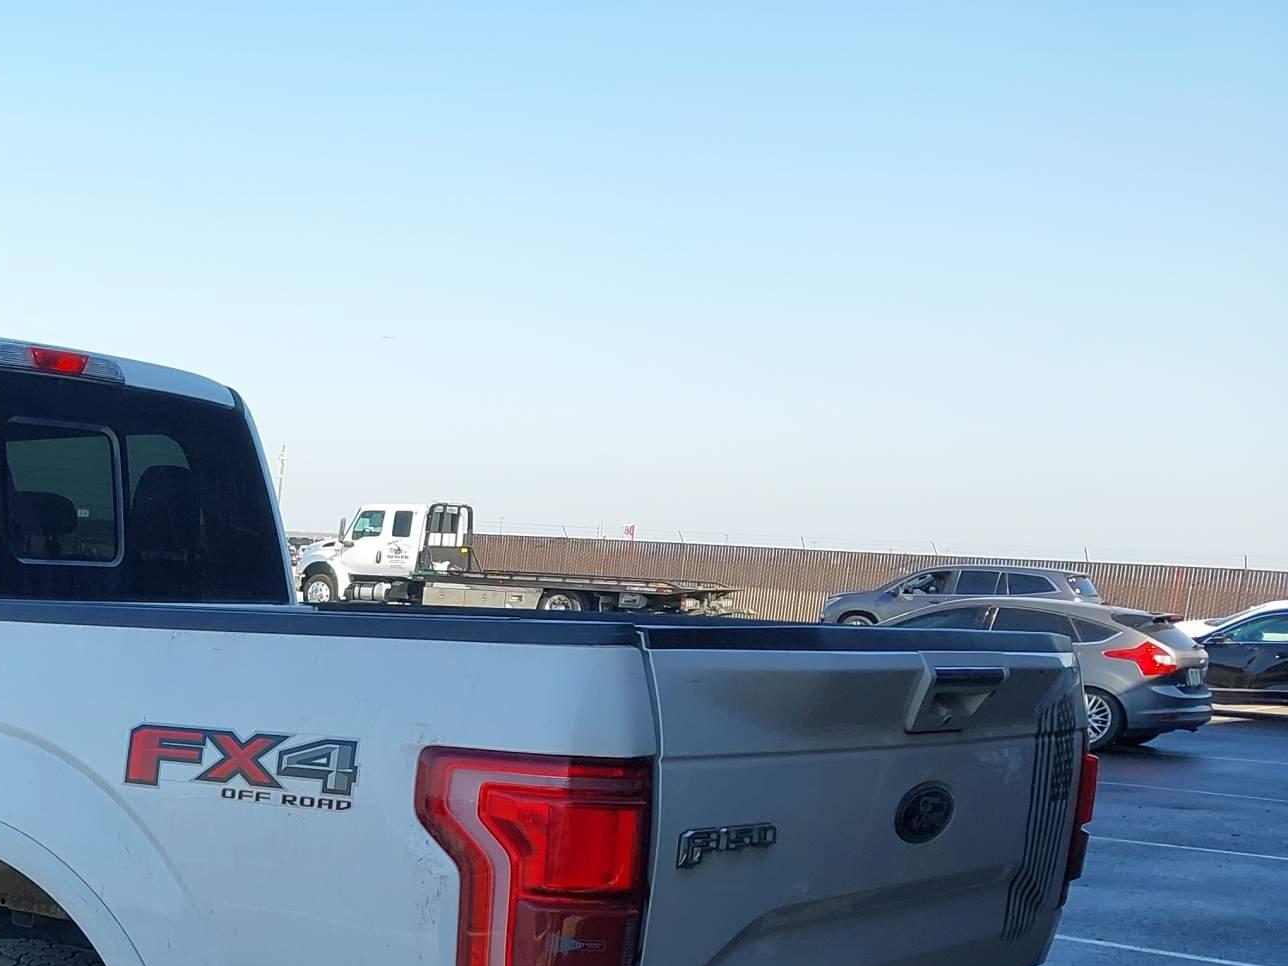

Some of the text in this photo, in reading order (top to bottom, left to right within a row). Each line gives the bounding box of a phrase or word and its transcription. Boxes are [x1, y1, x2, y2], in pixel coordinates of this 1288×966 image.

[124, 724, 359, 796] FX4
[221, 788, 352, 810] OFF ROAD
